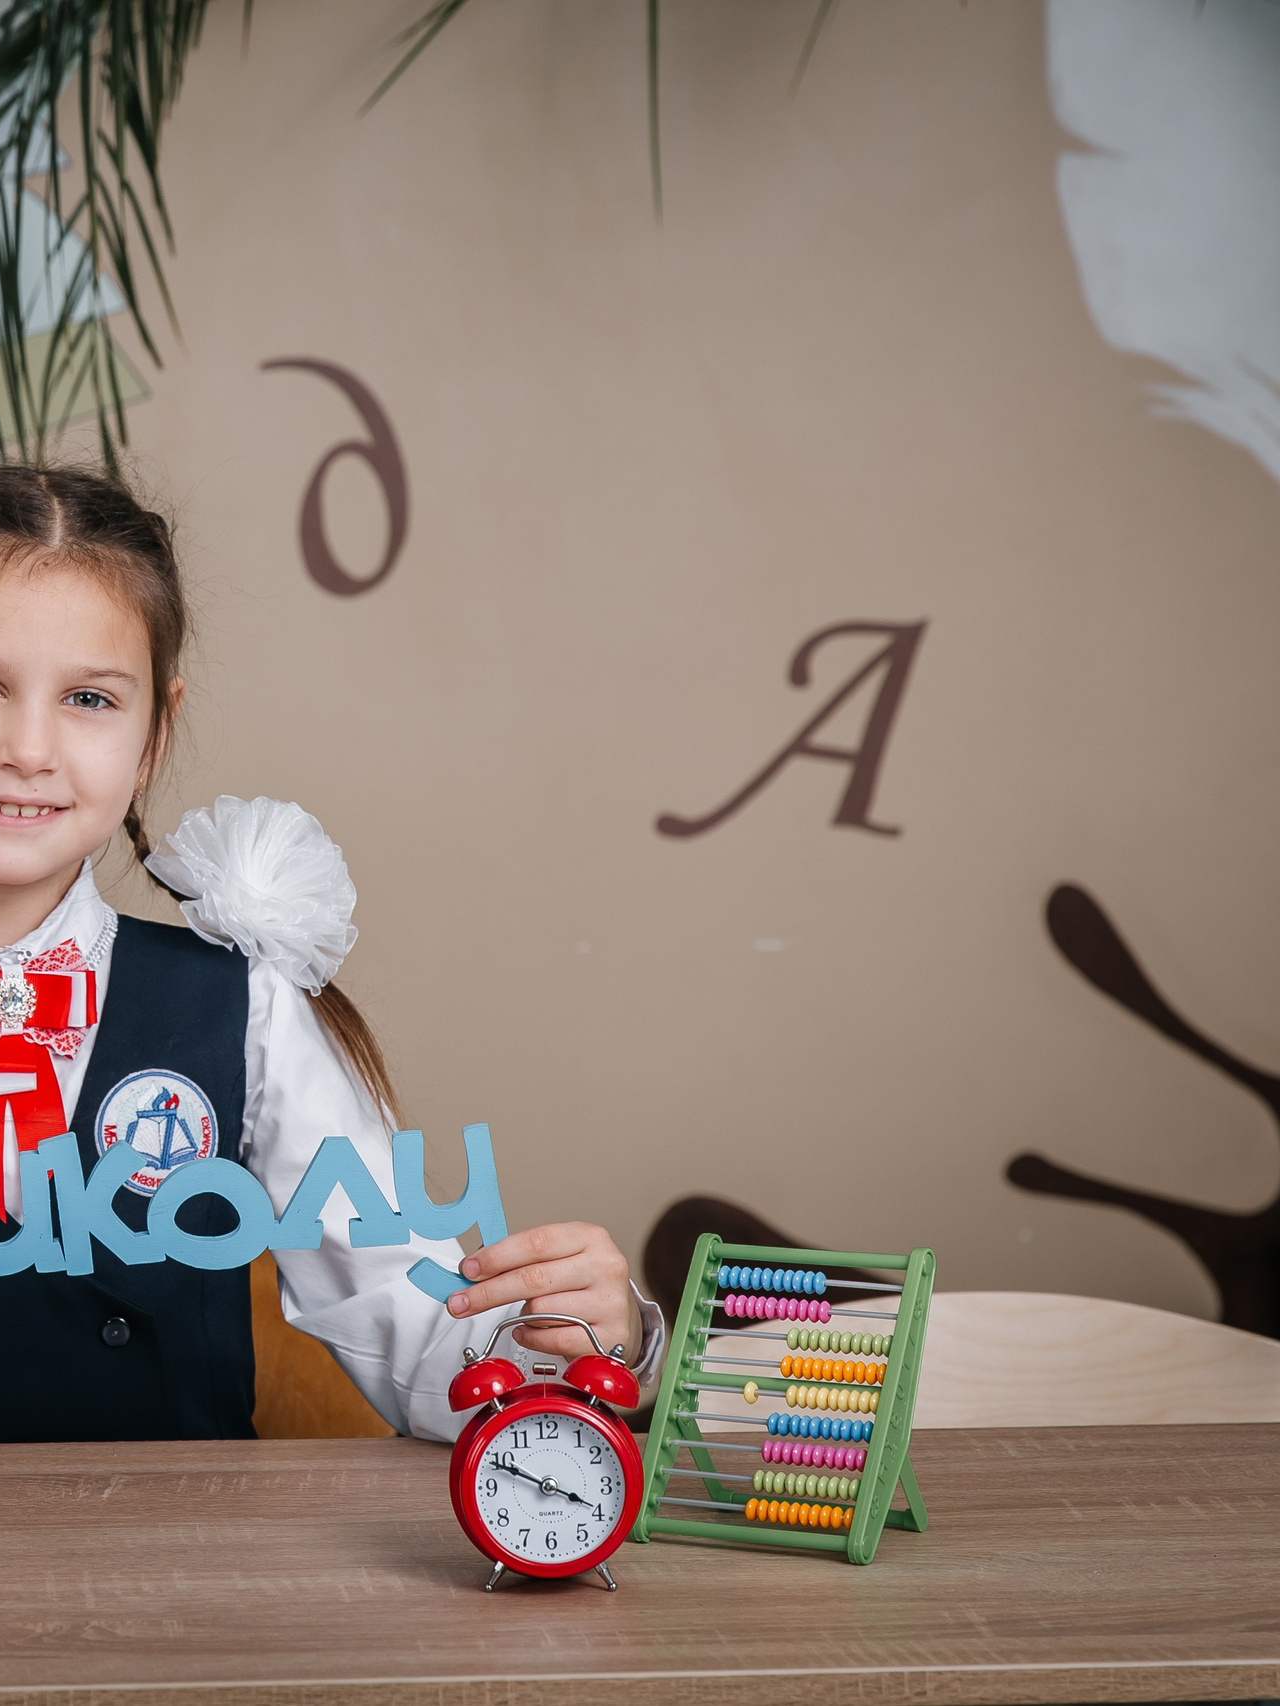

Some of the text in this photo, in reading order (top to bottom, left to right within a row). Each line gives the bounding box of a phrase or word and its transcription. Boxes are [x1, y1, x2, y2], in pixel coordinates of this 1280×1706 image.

[510, 1430, 531, 1449] 11
[534, 1420, 560, 1440] 12
[573, 1429, 585, 1448] 1
[491, 1451, 515, 1471] 10
[589, 1446, 603, 1465] 2
[485, 1478, 498, 1498] 9
[600, 1476, 613, 1495] 3
[497, 1508, 510, 1527] 8
[591, 1503, 606, 1522] 4
[518, 1528, 531, 1547] 7
[545, 1531, 558, 1550] 6
[576, 1523, 589, 1542] 5
